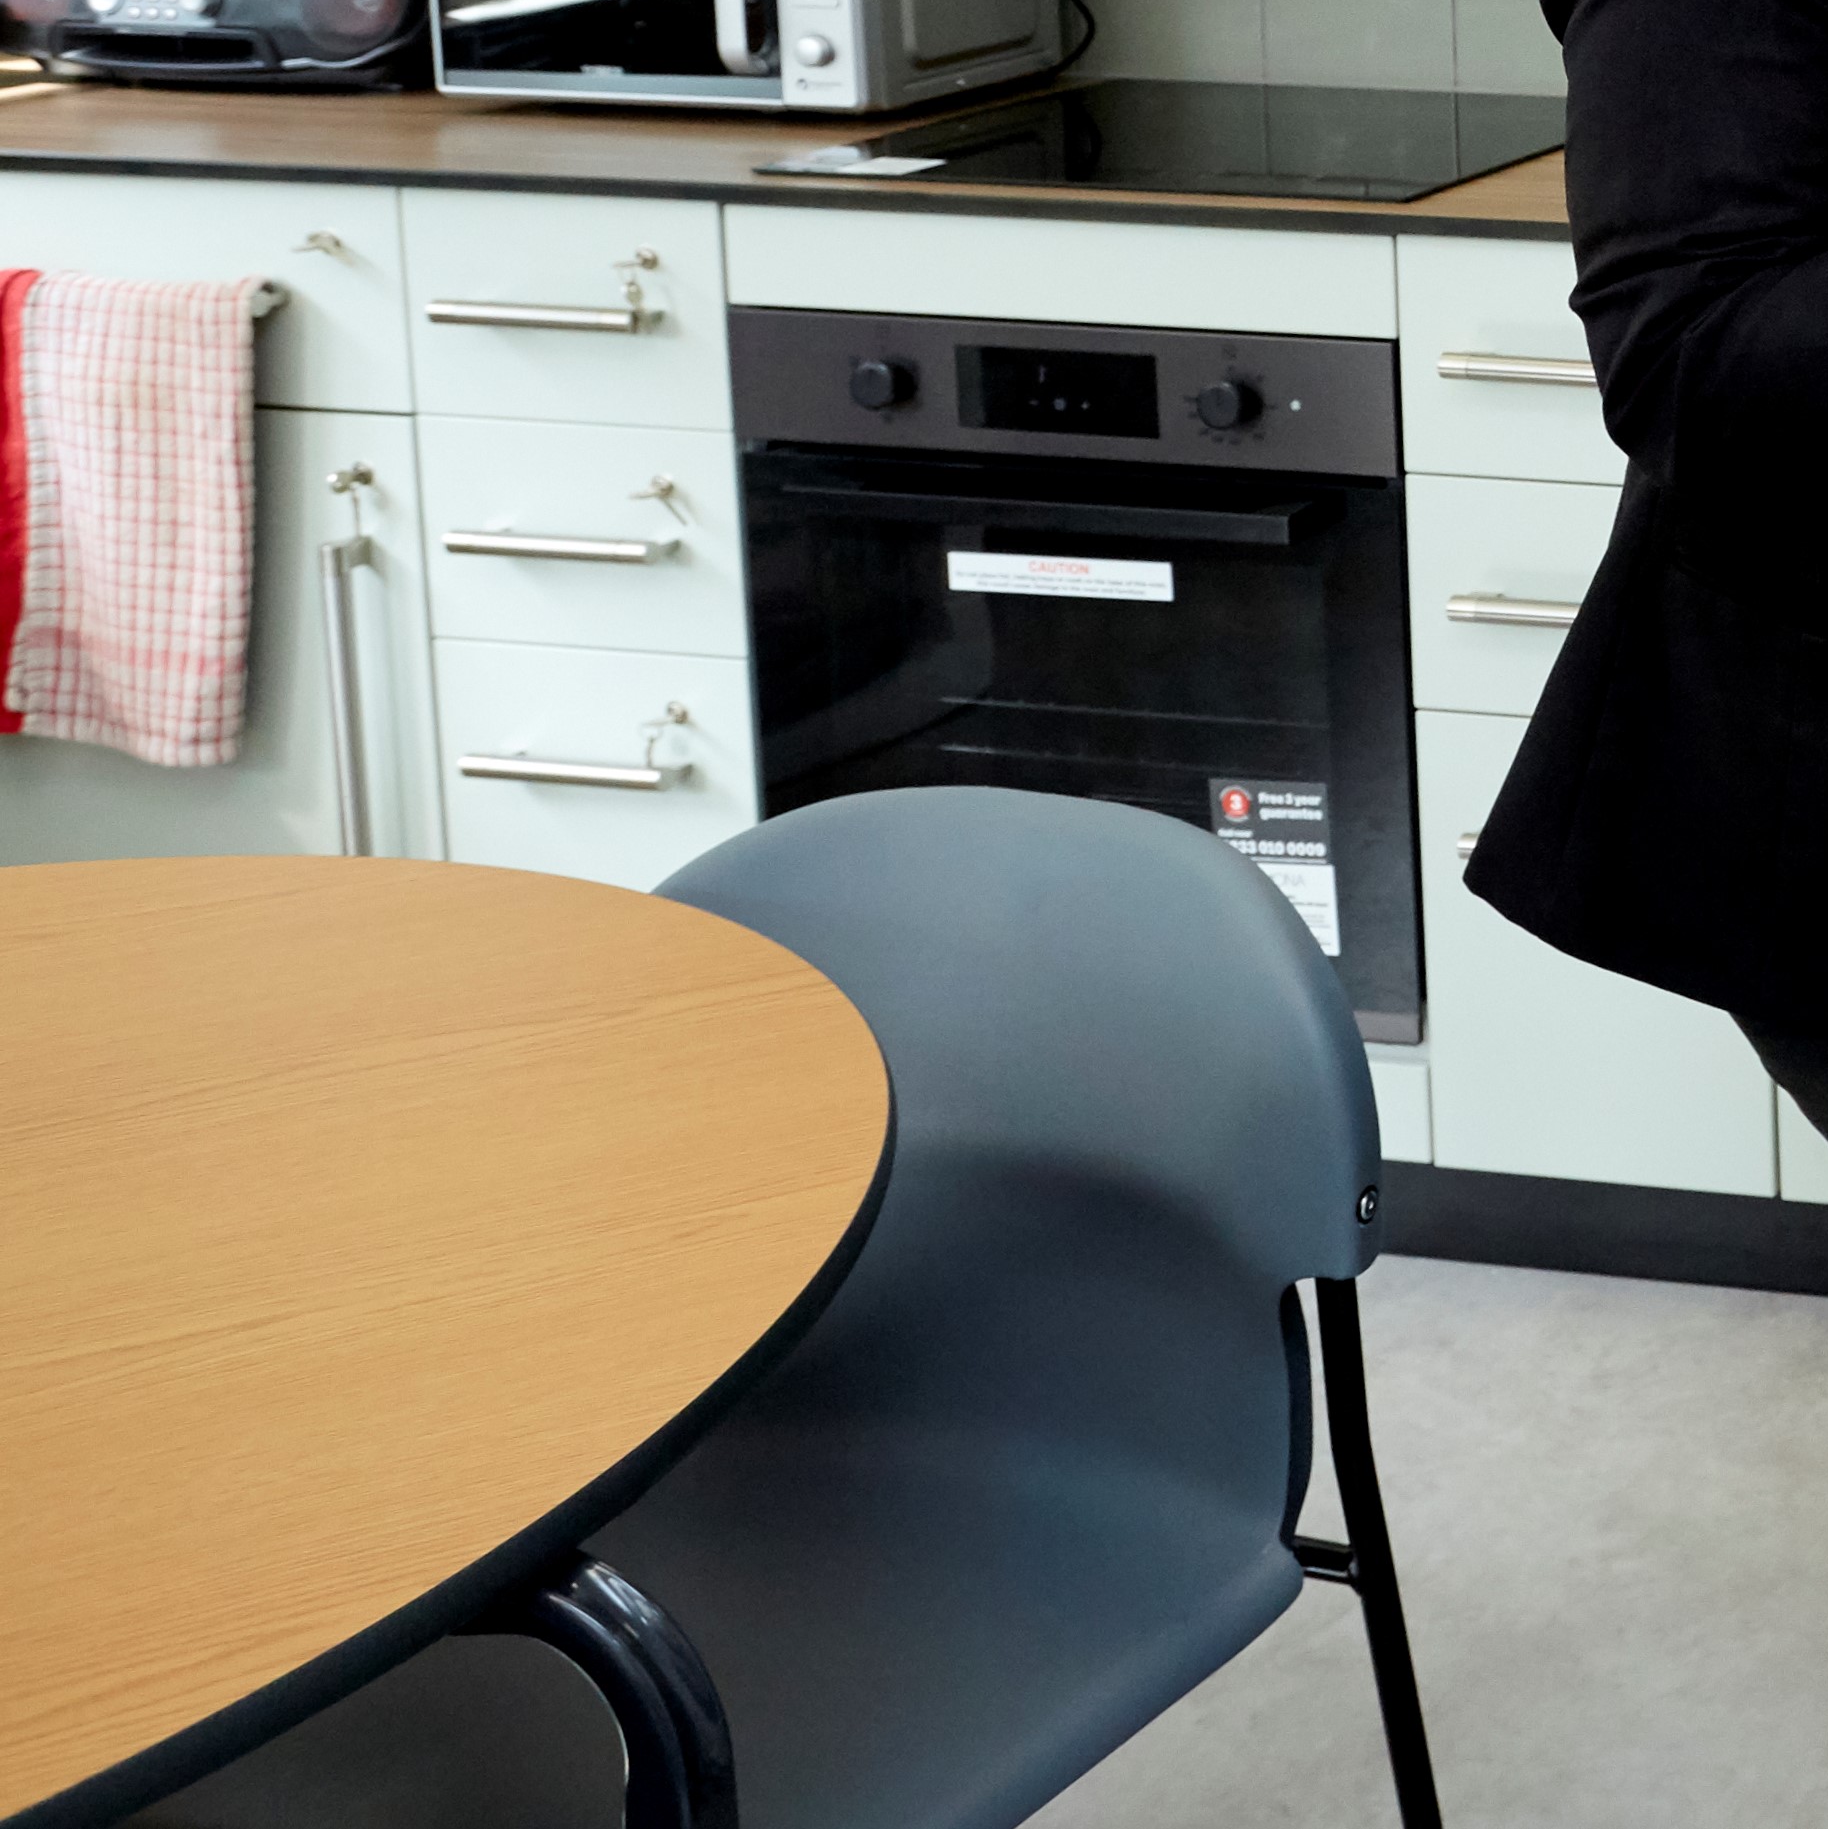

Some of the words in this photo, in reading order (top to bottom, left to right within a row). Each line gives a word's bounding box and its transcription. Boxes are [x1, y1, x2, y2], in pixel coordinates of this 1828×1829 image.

[1028, 560, 1090, 575] CAUTION
[1230, 794, 1242, 810] 3
[1258, 791, 1284, 805] Free
[1293, 794, 1322, 807] year
[1259, 807, 1324, 821] guarantee
